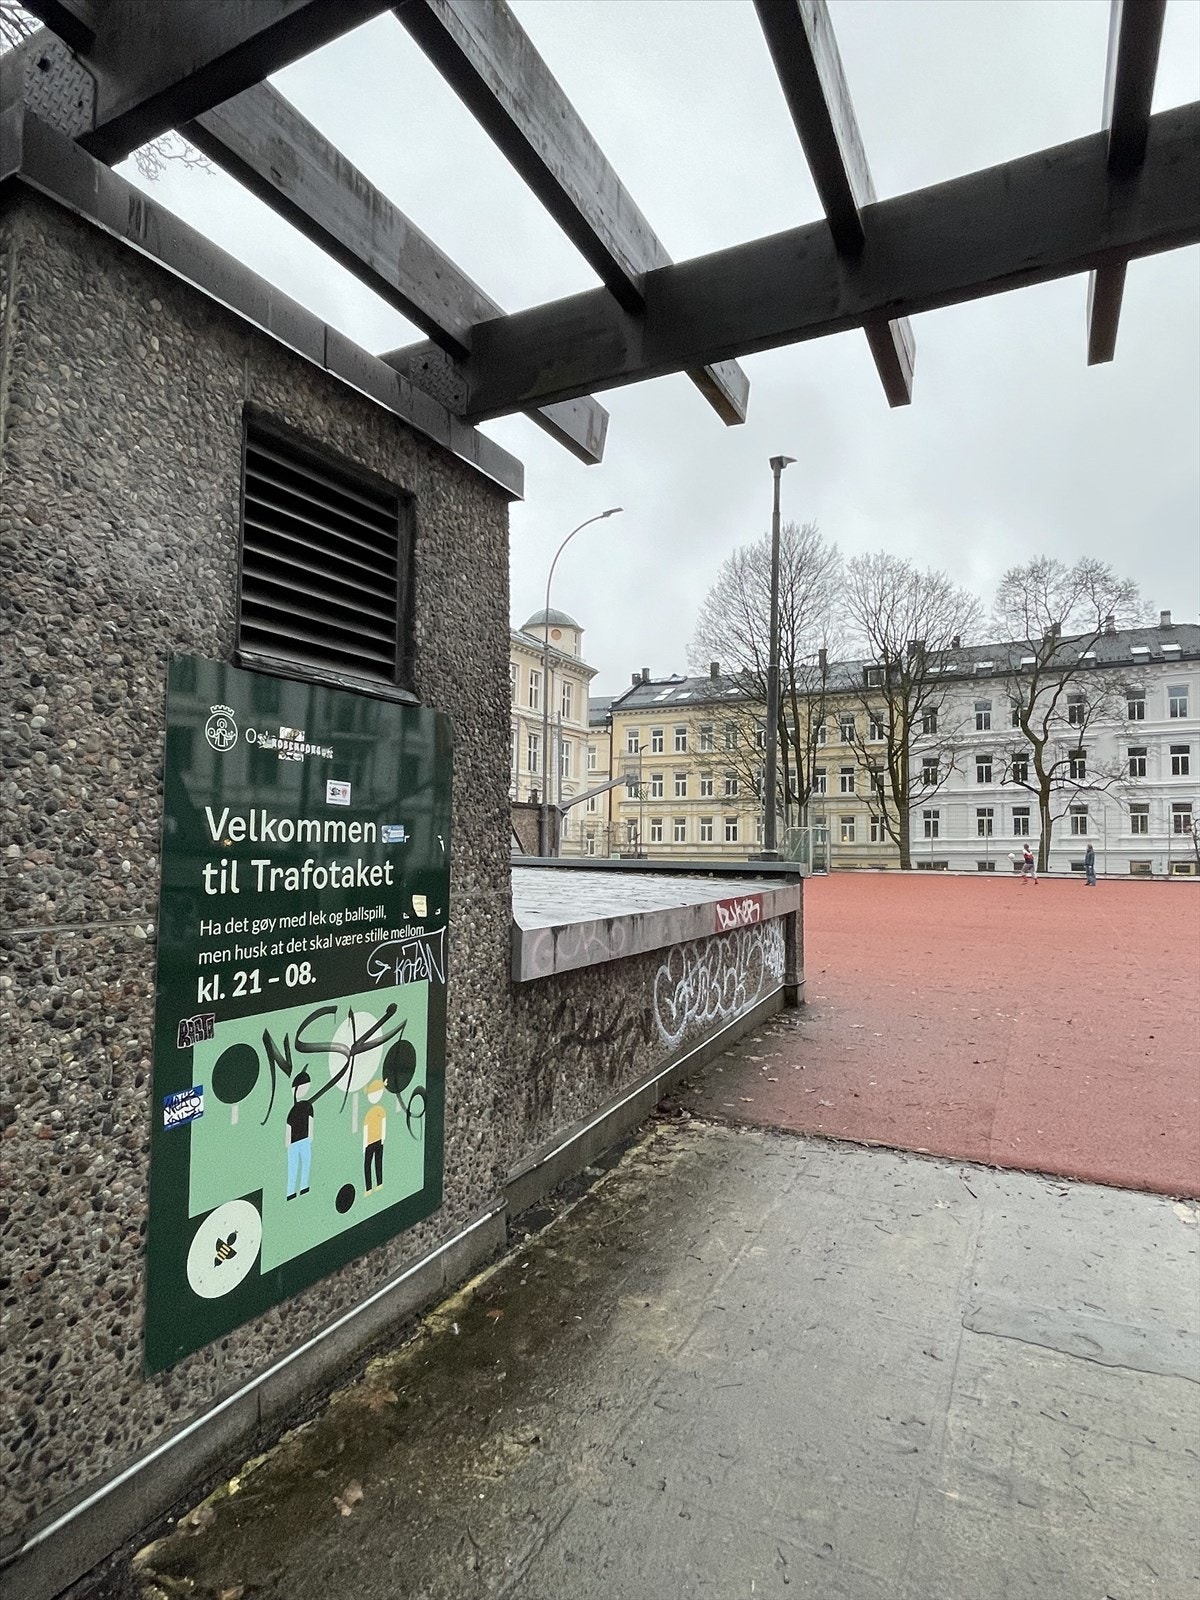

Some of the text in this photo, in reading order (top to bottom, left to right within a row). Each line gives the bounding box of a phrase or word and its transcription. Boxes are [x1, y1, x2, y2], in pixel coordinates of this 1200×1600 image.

[205, 806, 376, 843] Velkommen
[202, 858, 394, 895] til Trafotaket
[200, 904, 387, 936] Ha det gøy med lek og ballspill,
[198, 924, 425, 965] men husk at det skal være stille mellom
[197, 974, 226, 1004] kl.
[232, 968, 262, 998] 21
[285, 961, 317, 988] 08.
